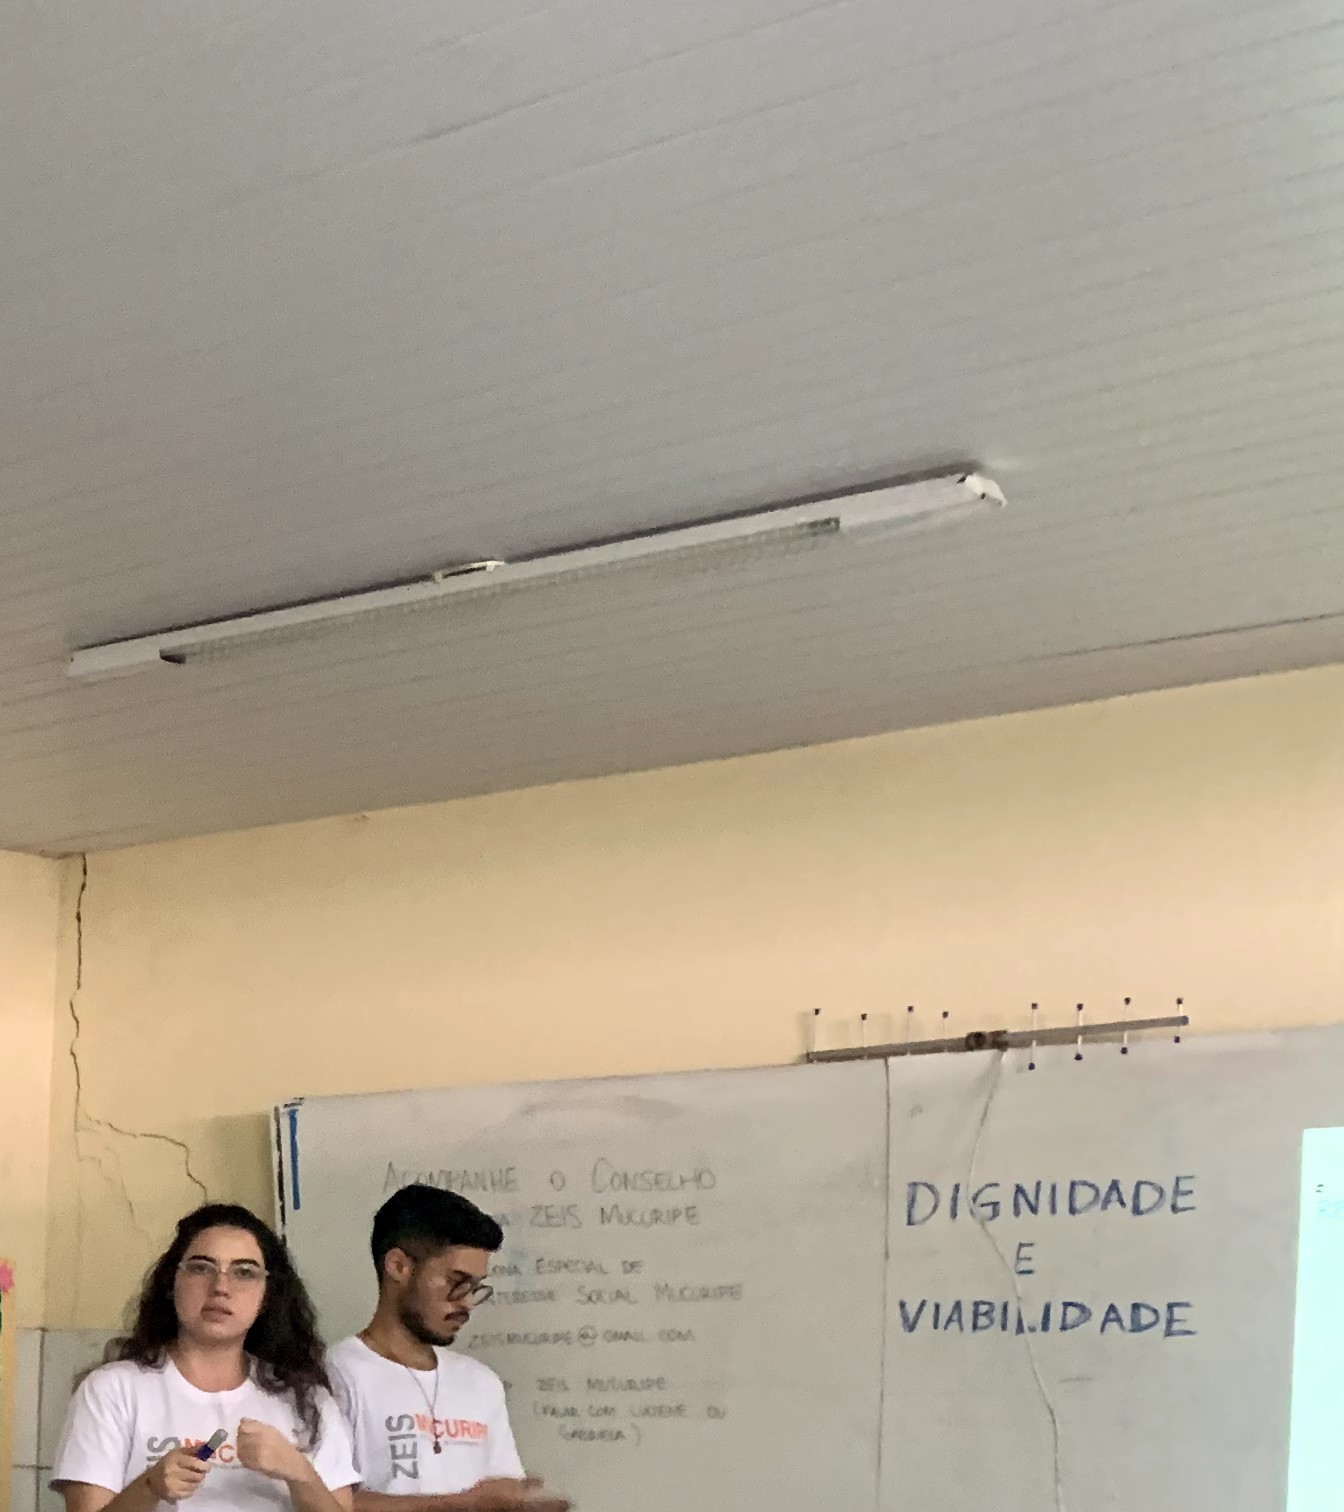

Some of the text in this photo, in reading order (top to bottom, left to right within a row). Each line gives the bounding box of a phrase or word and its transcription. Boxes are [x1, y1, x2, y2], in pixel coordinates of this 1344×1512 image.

[549, 1170, 567, 1192] O
[530, 1204, 583, 1229] ZEIS
[905, 1174, 1198, 1227] DIGNIDADE
[1014, 1241, 1036, 1275] E
[898, 1298, 1198, 1339] VIABILIDADE
[385, 1412, 420, 1480] ZEIS
